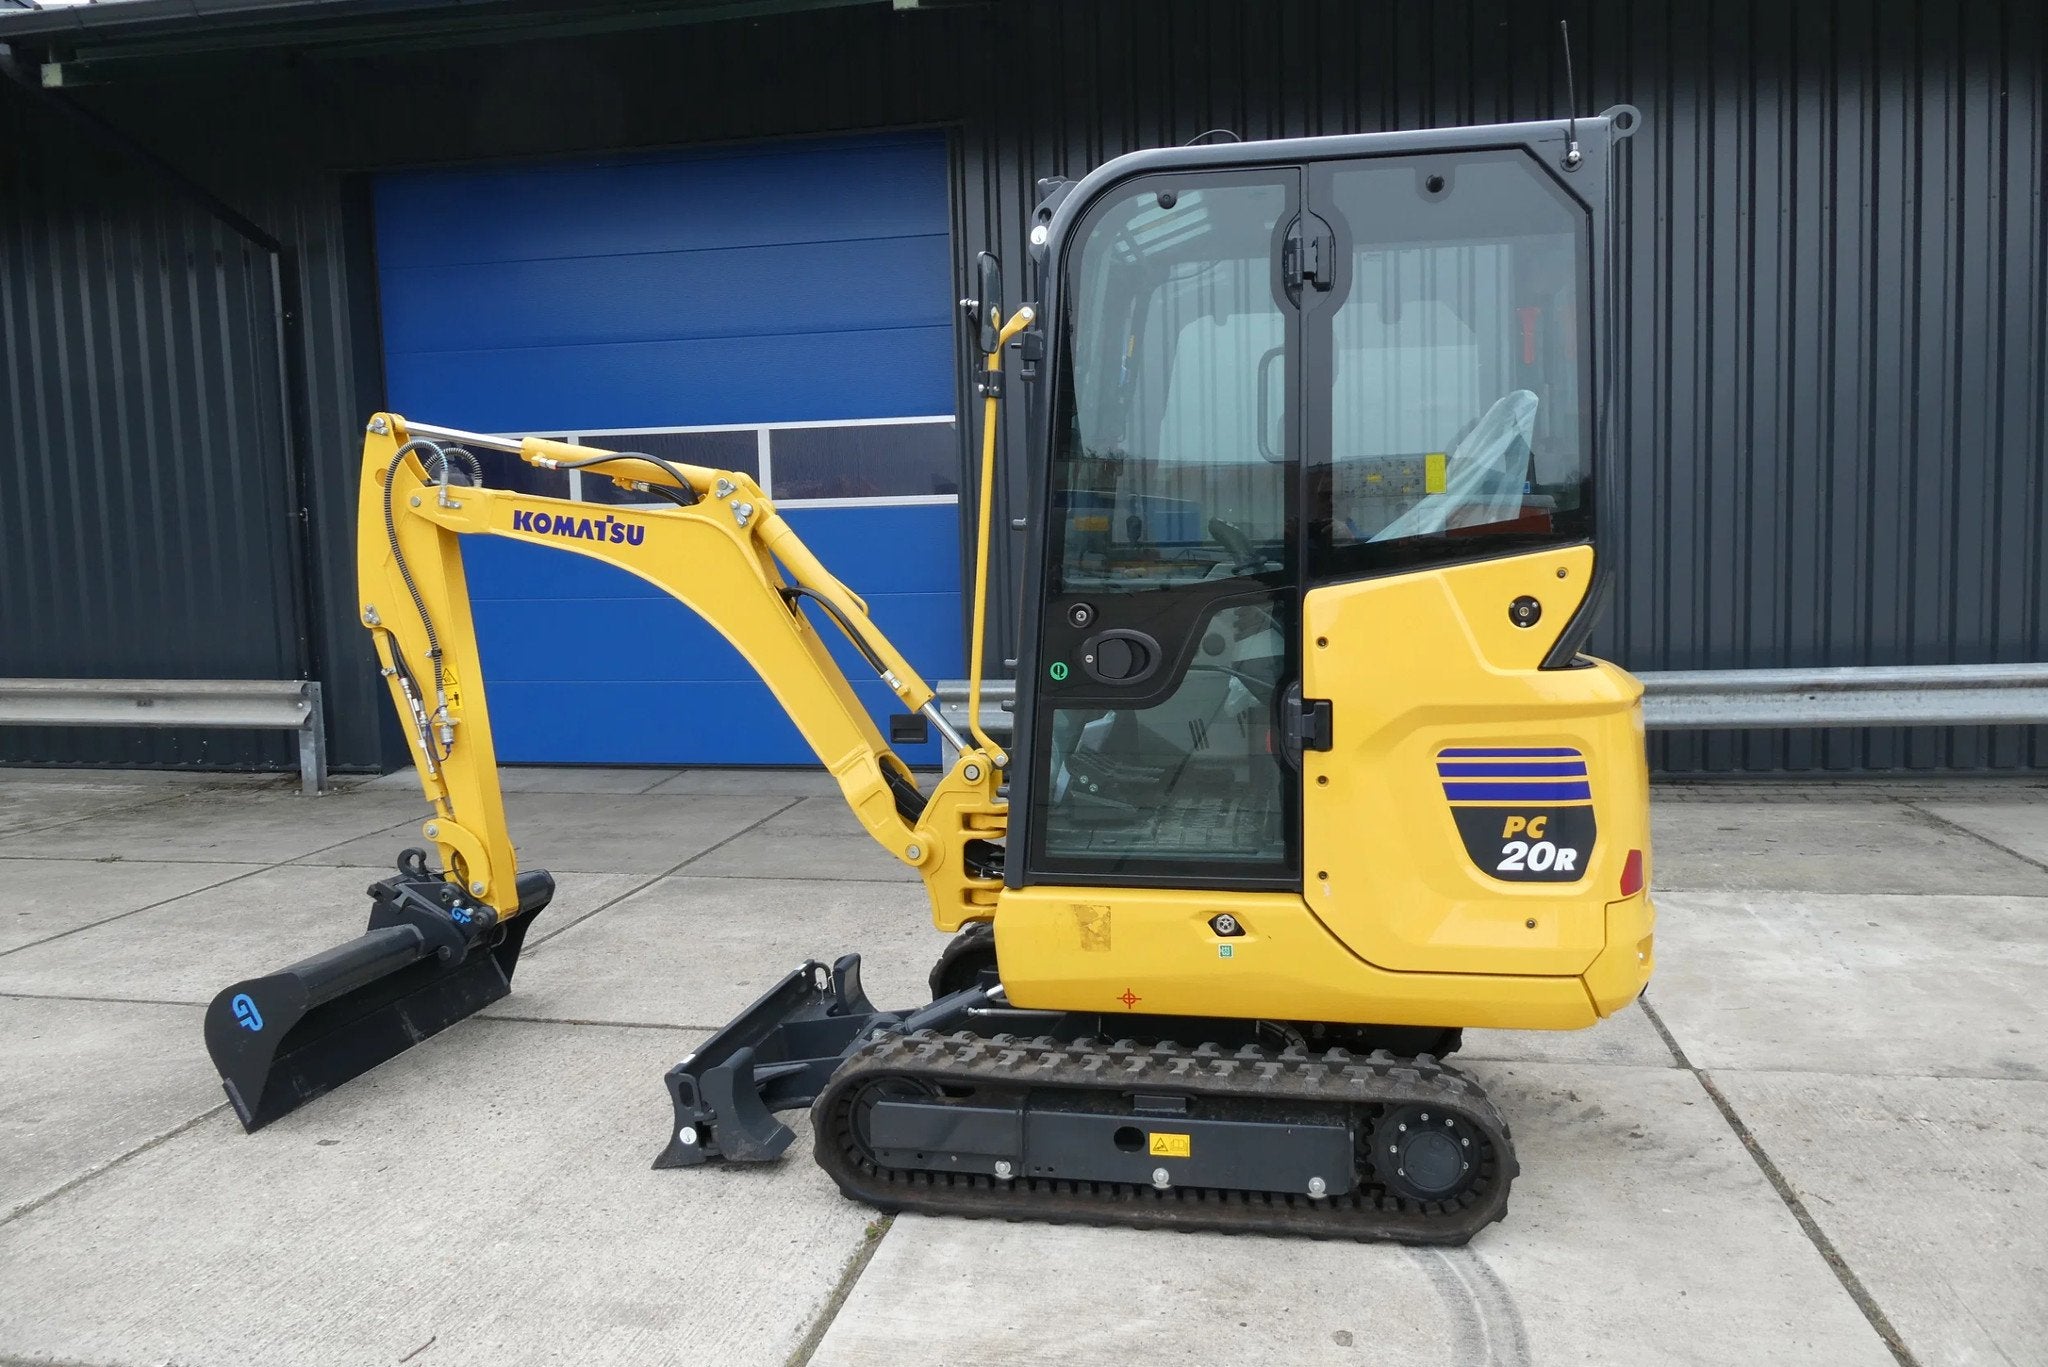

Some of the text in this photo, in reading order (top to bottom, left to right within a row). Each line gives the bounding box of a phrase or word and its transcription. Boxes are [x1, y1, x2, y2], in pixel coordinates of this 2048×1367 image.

[513, 510, 645, 546] KOMATSU
[1502, 815, 1548, 839] PC
[1496, 840, 1577, 872] 20R
